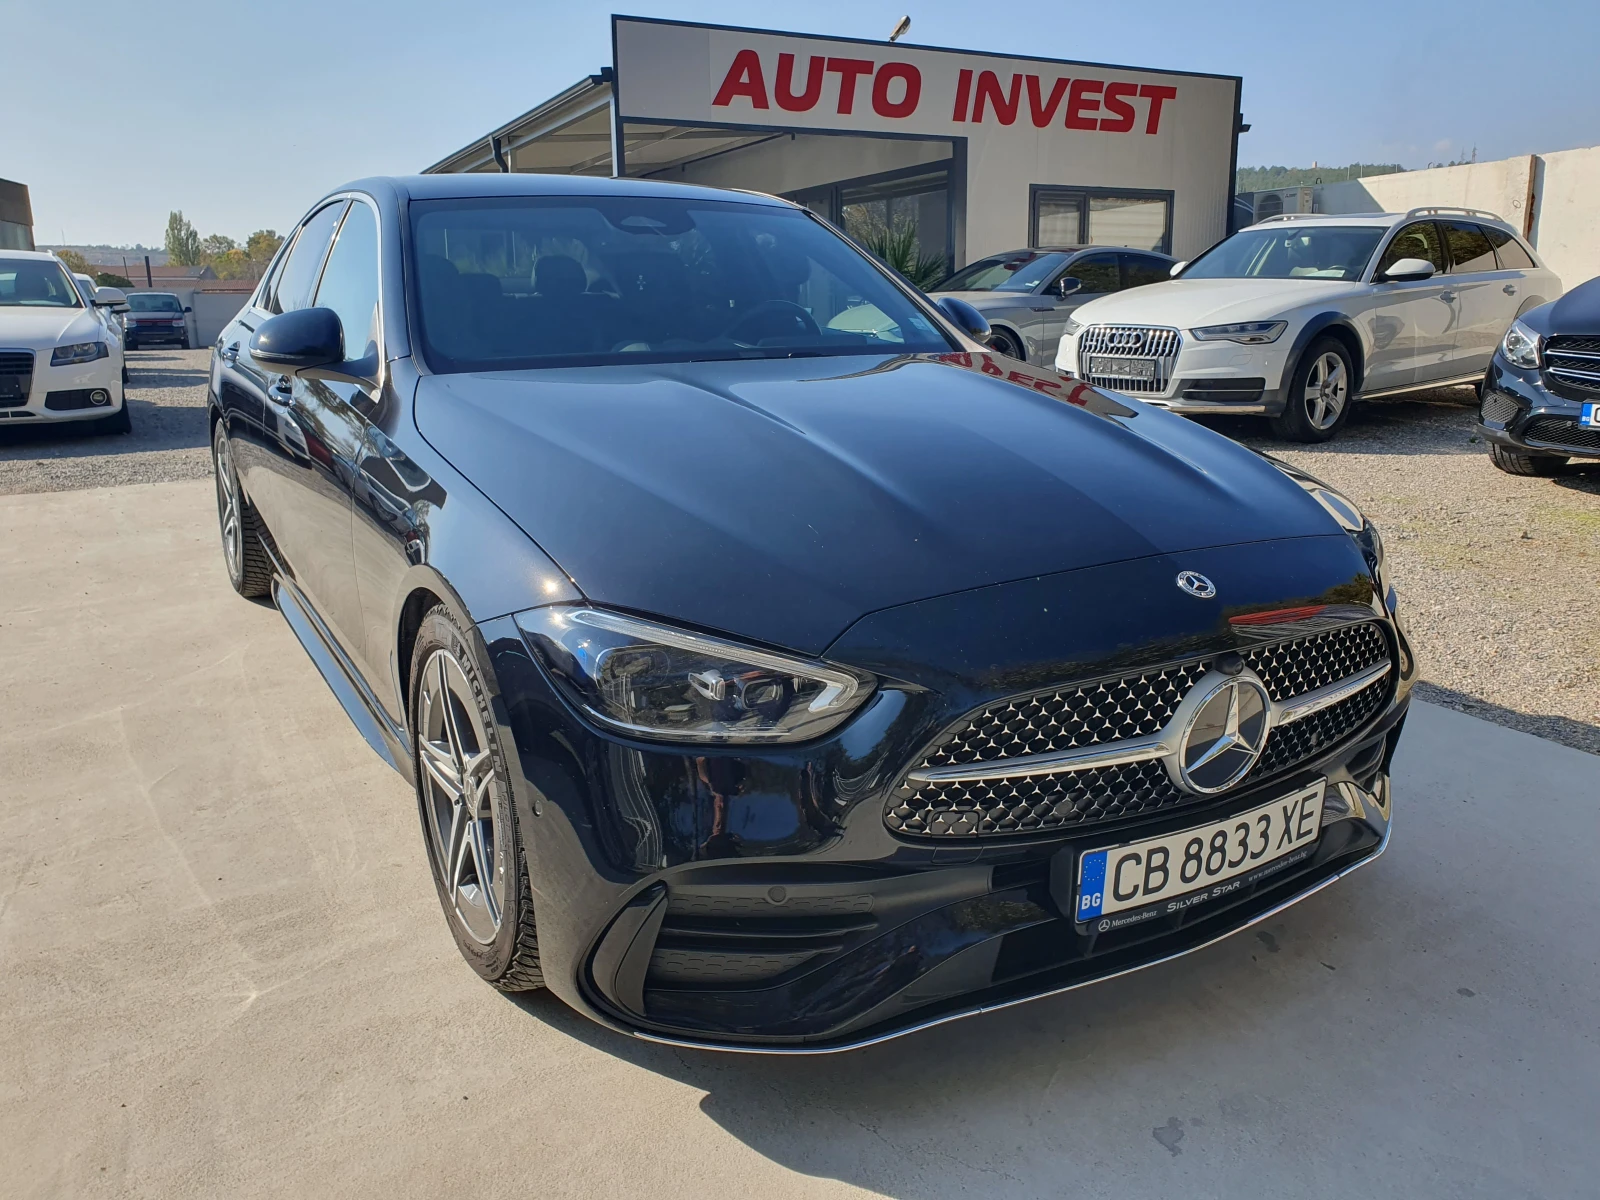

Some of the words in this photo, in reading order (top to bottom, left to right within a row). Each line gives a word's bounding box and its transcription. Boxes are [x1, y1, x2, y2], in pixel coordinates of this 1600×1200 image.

[712, 49, 922, 119] AUTO
[952, 69, 1177, 135] INVEST
[459, 654, 503, 773] MICHELIN
[1112, 846, 1170, 902] CB
[1180, 813, 1272, 884] 8833
[1276, 791, 1319, 852] XE
[1081, 894, 1101, 910] BG
[1111, 909, 1158, 928] Mercedes-Benz
[1166, 893, 1208, 912] SILVER
[1211, 880, 1241, 898] STAR
